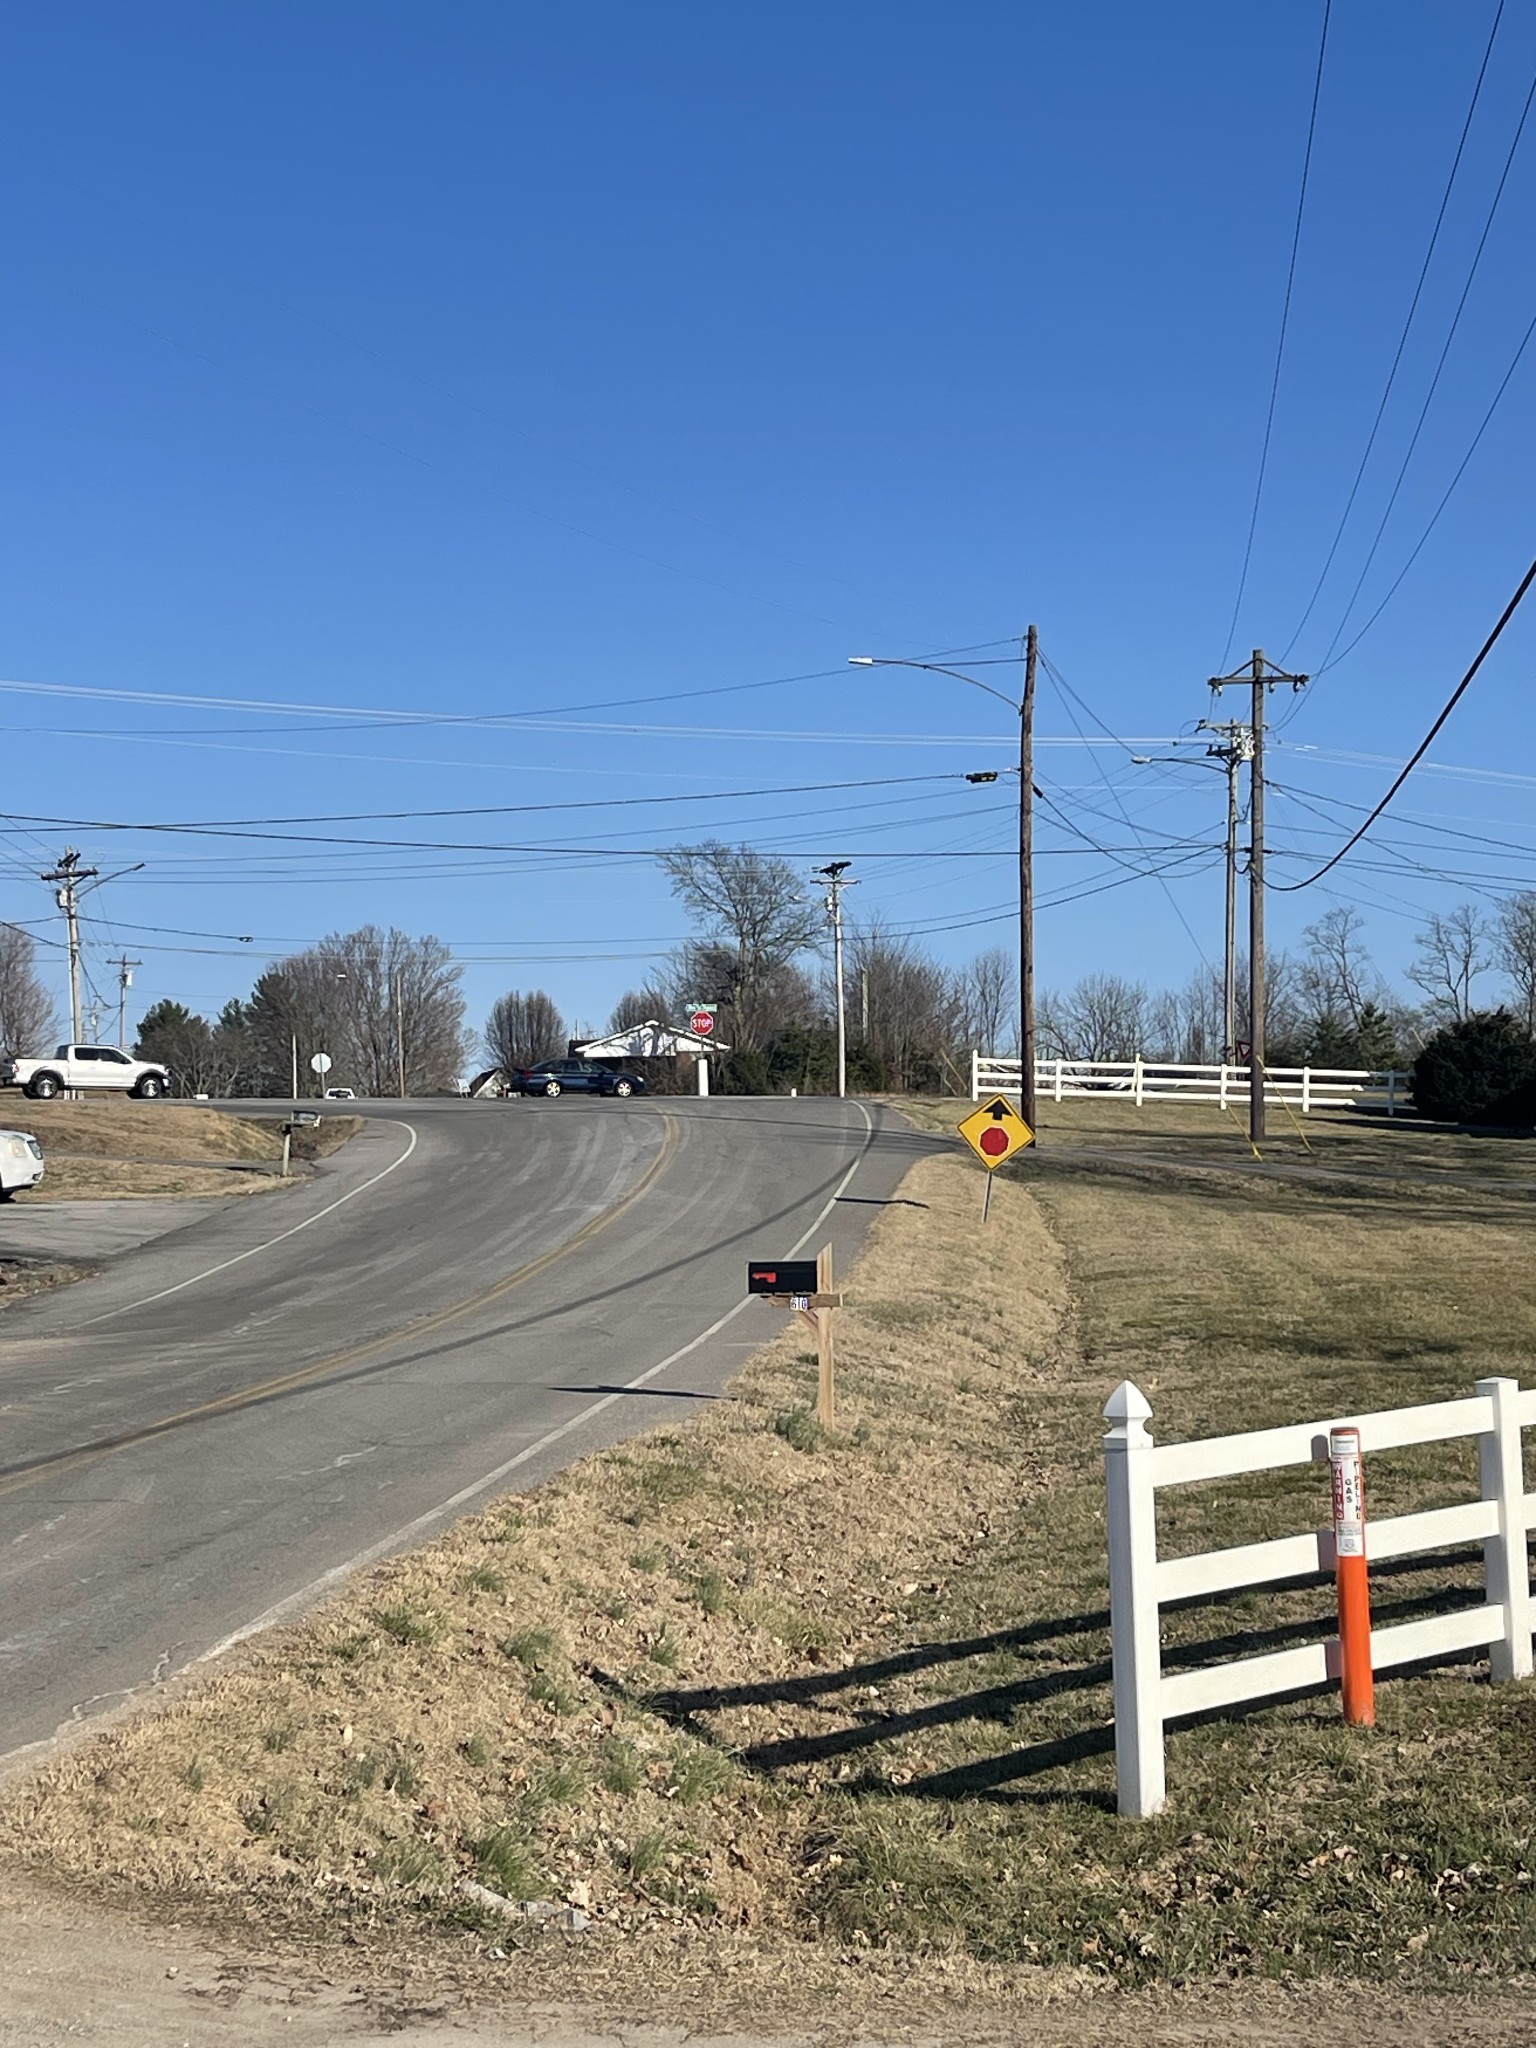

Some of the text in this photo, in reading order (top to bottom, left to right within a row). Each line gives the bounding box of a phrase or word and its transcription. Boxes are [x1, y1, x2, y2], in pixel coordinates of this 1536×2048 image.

[692, 1018, 712, 1028] STOP
[1333, 1461, 1344, 1519] WARNING
[1345, 1478, 1353, 1503] GAS
[1353, 1460, 1362, 1520] PIPELINE
